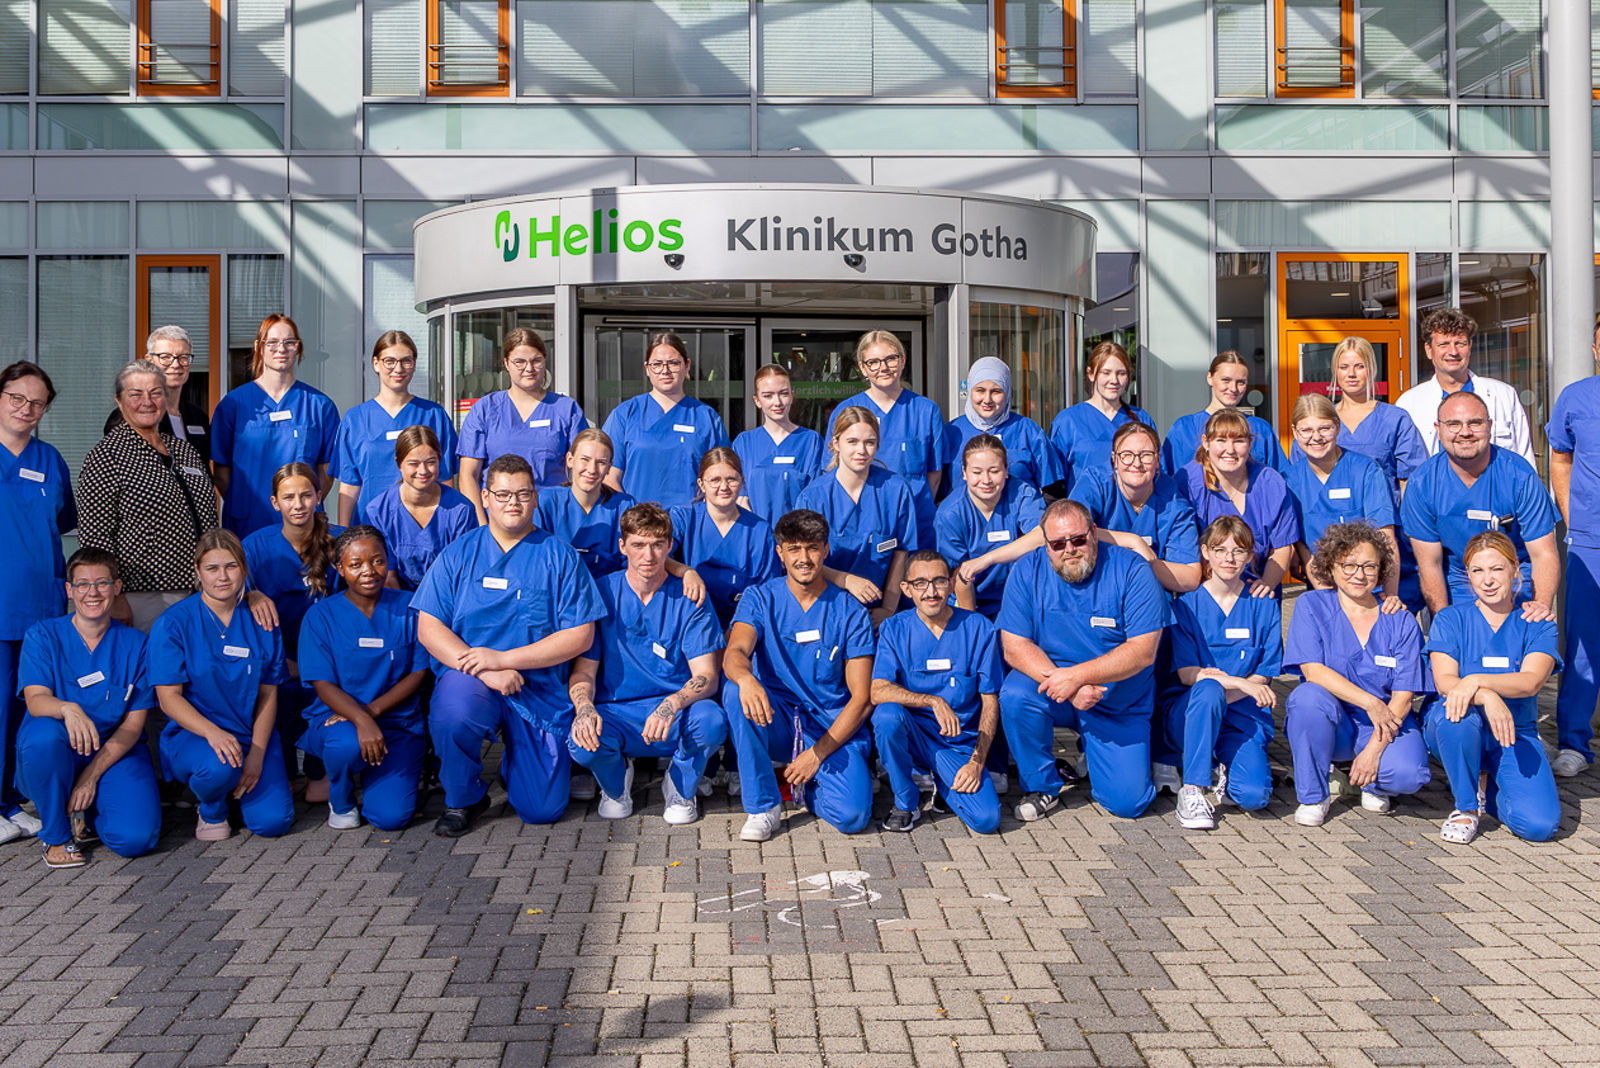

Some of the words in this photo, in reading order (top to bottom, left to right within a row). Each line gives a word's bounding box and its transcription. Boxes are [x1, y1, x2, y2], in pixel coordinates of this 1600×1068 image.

[529, 208, 684, 258] Helios
[727, 216, 914, 252] Klinikum
[931, 223, 1028, 260] Gotha
